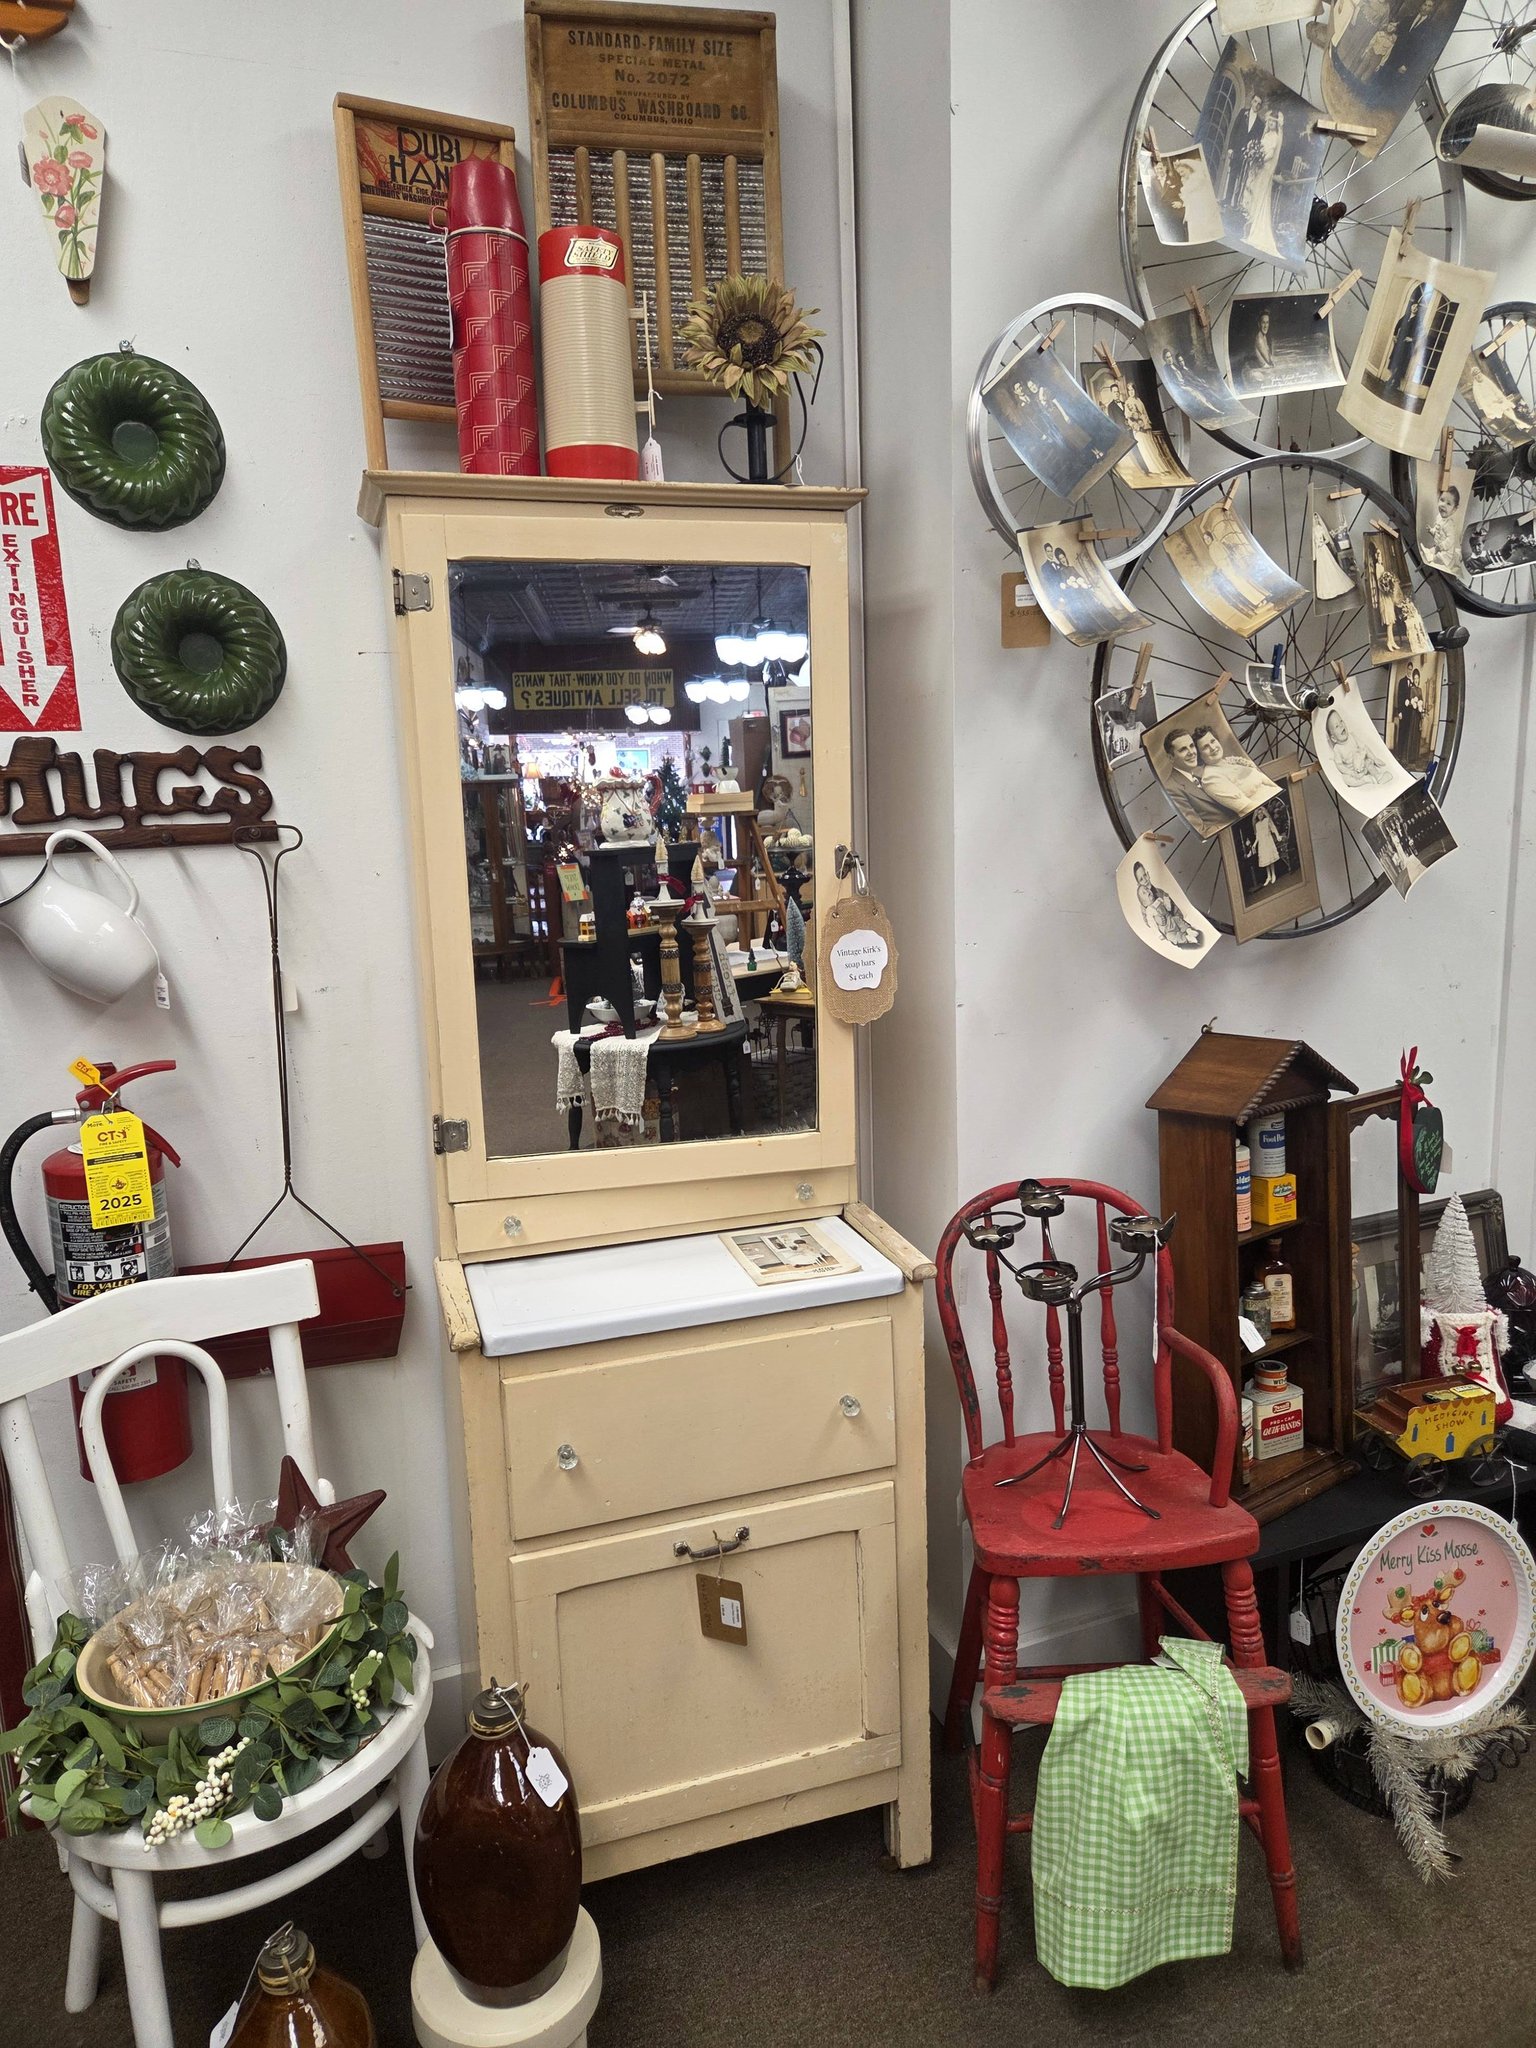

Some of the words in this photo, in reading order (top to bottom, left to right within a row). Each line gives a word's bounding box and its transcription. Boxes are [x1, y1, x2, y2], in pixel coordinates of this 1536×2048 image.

[703, 39, 734, 58] SIZE
[599, 53, 655, 67] SPECIAL
[662, 58, 706, 70] METAL
[615, 69, 641, 84] No.
[646, 71, 690, 87] 2072
[552, 92, 626, 112] COLUMBUS
[638, 98, 721, 120] WASHBOARD
[614, 112, 668, 125] COLUMBUS,
[671, 117, 694, 125] OHIO
[389, 154, 453, 191] HAN
[2, 533, 40, 708] EXTINGUISHER
[837, 949, 861, 957] Vintage
[862, 945, 881, 954] Kirk's
[844, 961, 860, 969] soap
[858, 971, 874, 980] each
[100, 1194, 142, 1211] 2025
[77, 1283, 96, 1291] FOX
[99, 1276, 137, 1290] VALLEY
[72, 1289, 92, 1297] FIRE
[114, 1376, 137, 1386] SAFETY
[1424, 1409, 1474, 1425] MEDICINE
[1435, 1419, 1465, 1431] SHOW
[1380, 1551, 1413, 1575] Merry
[1417, 1544, 1442, 1565] Kiss
[1444, 1539, 1479, 1560] Moose
